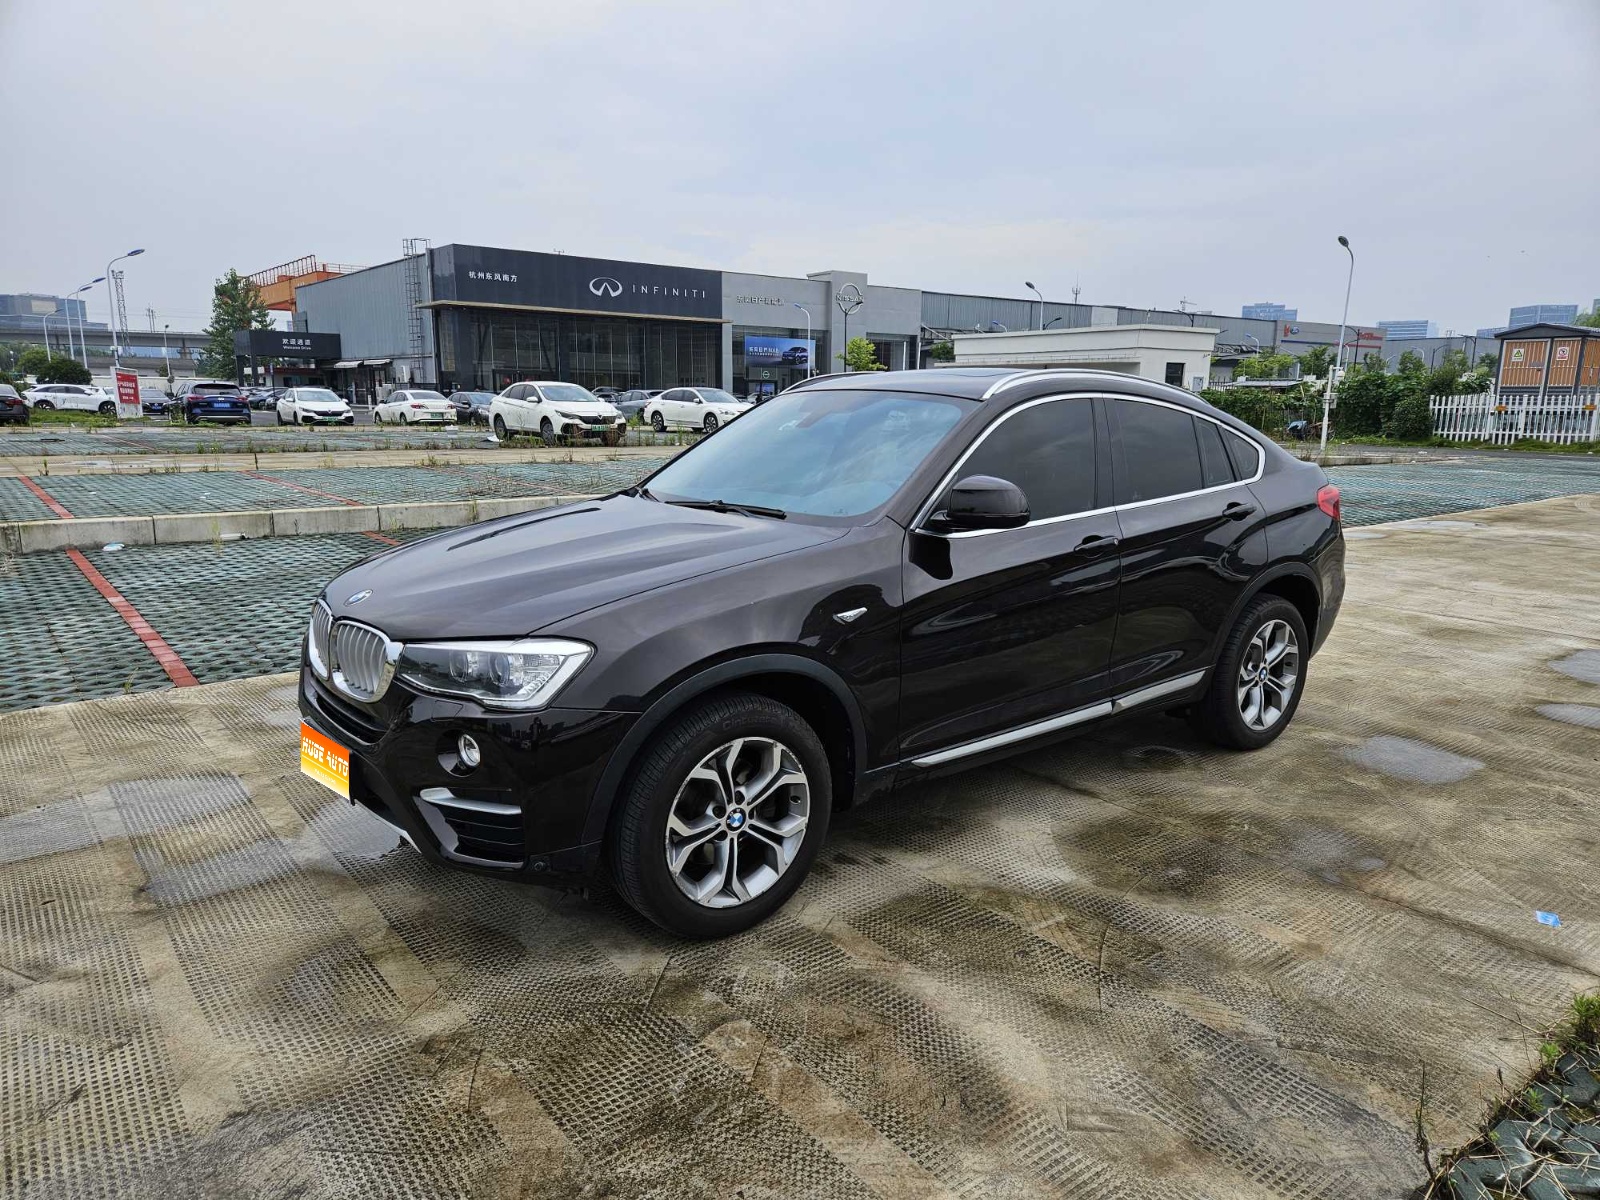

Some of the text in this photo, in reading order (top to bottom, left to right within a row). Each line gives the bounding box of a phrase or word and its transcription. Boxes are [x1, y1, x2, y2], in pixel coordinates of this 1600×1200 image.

[468, 270, 518, 283] 杭州东风南方
[632, 284, 705, 299] INFINITI
[835, 294, 864, 303] NISSAN
